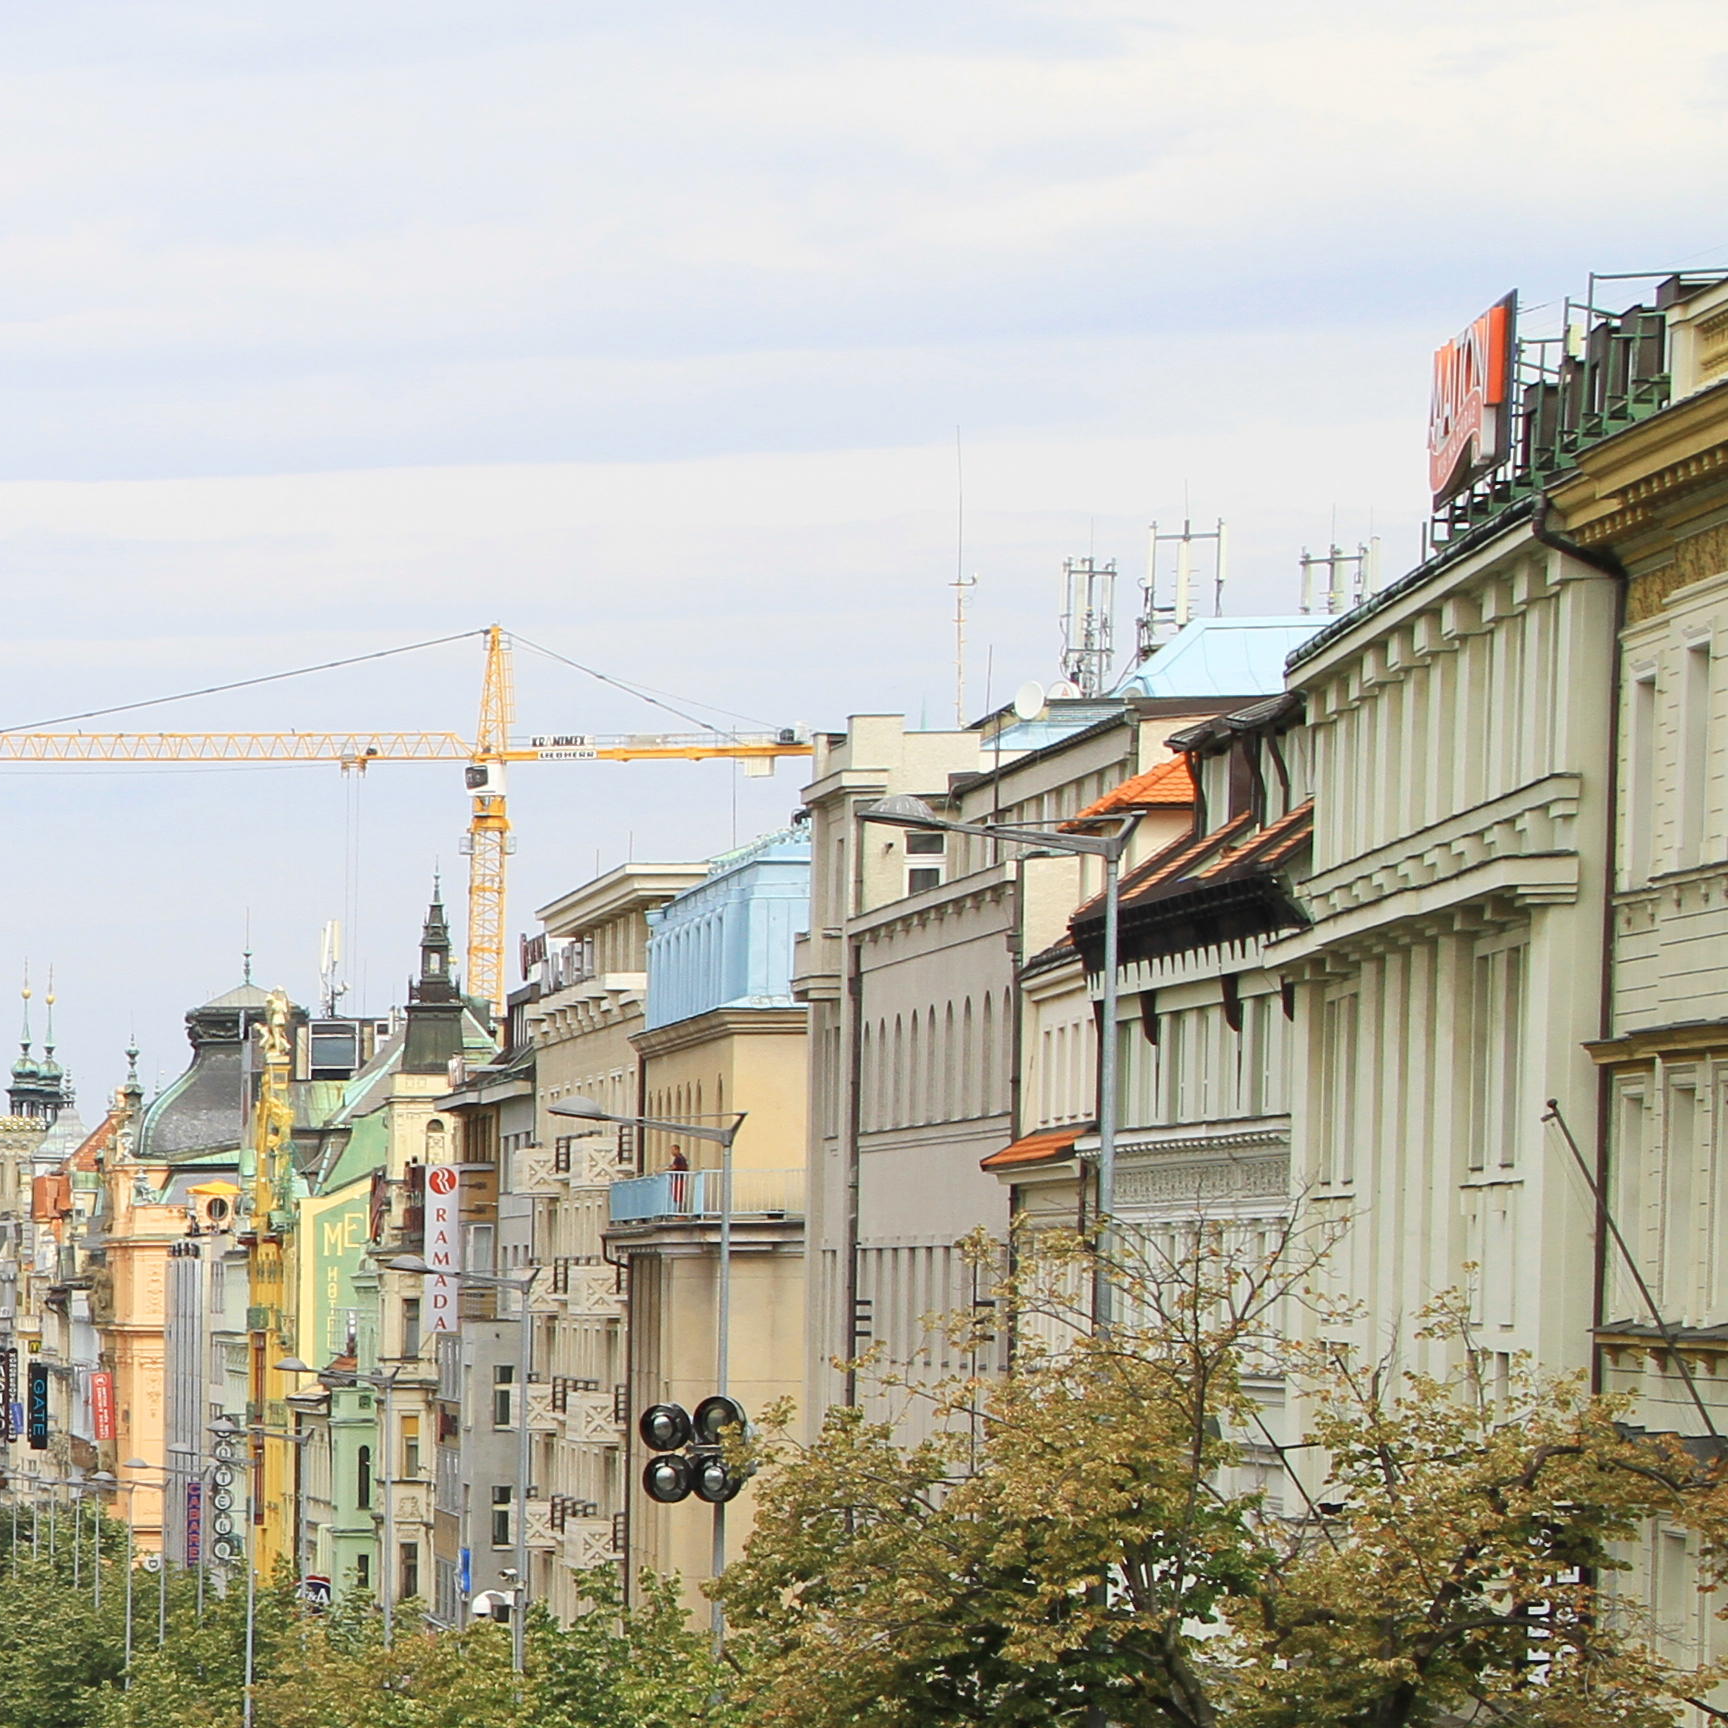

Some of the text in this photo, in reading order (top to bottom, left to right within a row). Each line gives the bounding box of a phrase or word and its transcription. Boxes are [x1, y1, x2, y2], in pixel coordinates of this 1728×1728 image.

[327, 1266, 338, 1349] HOTEL
[432, 1207, 451, 1331] RAMADA
[33, 1379, 45, 1436] GATE
